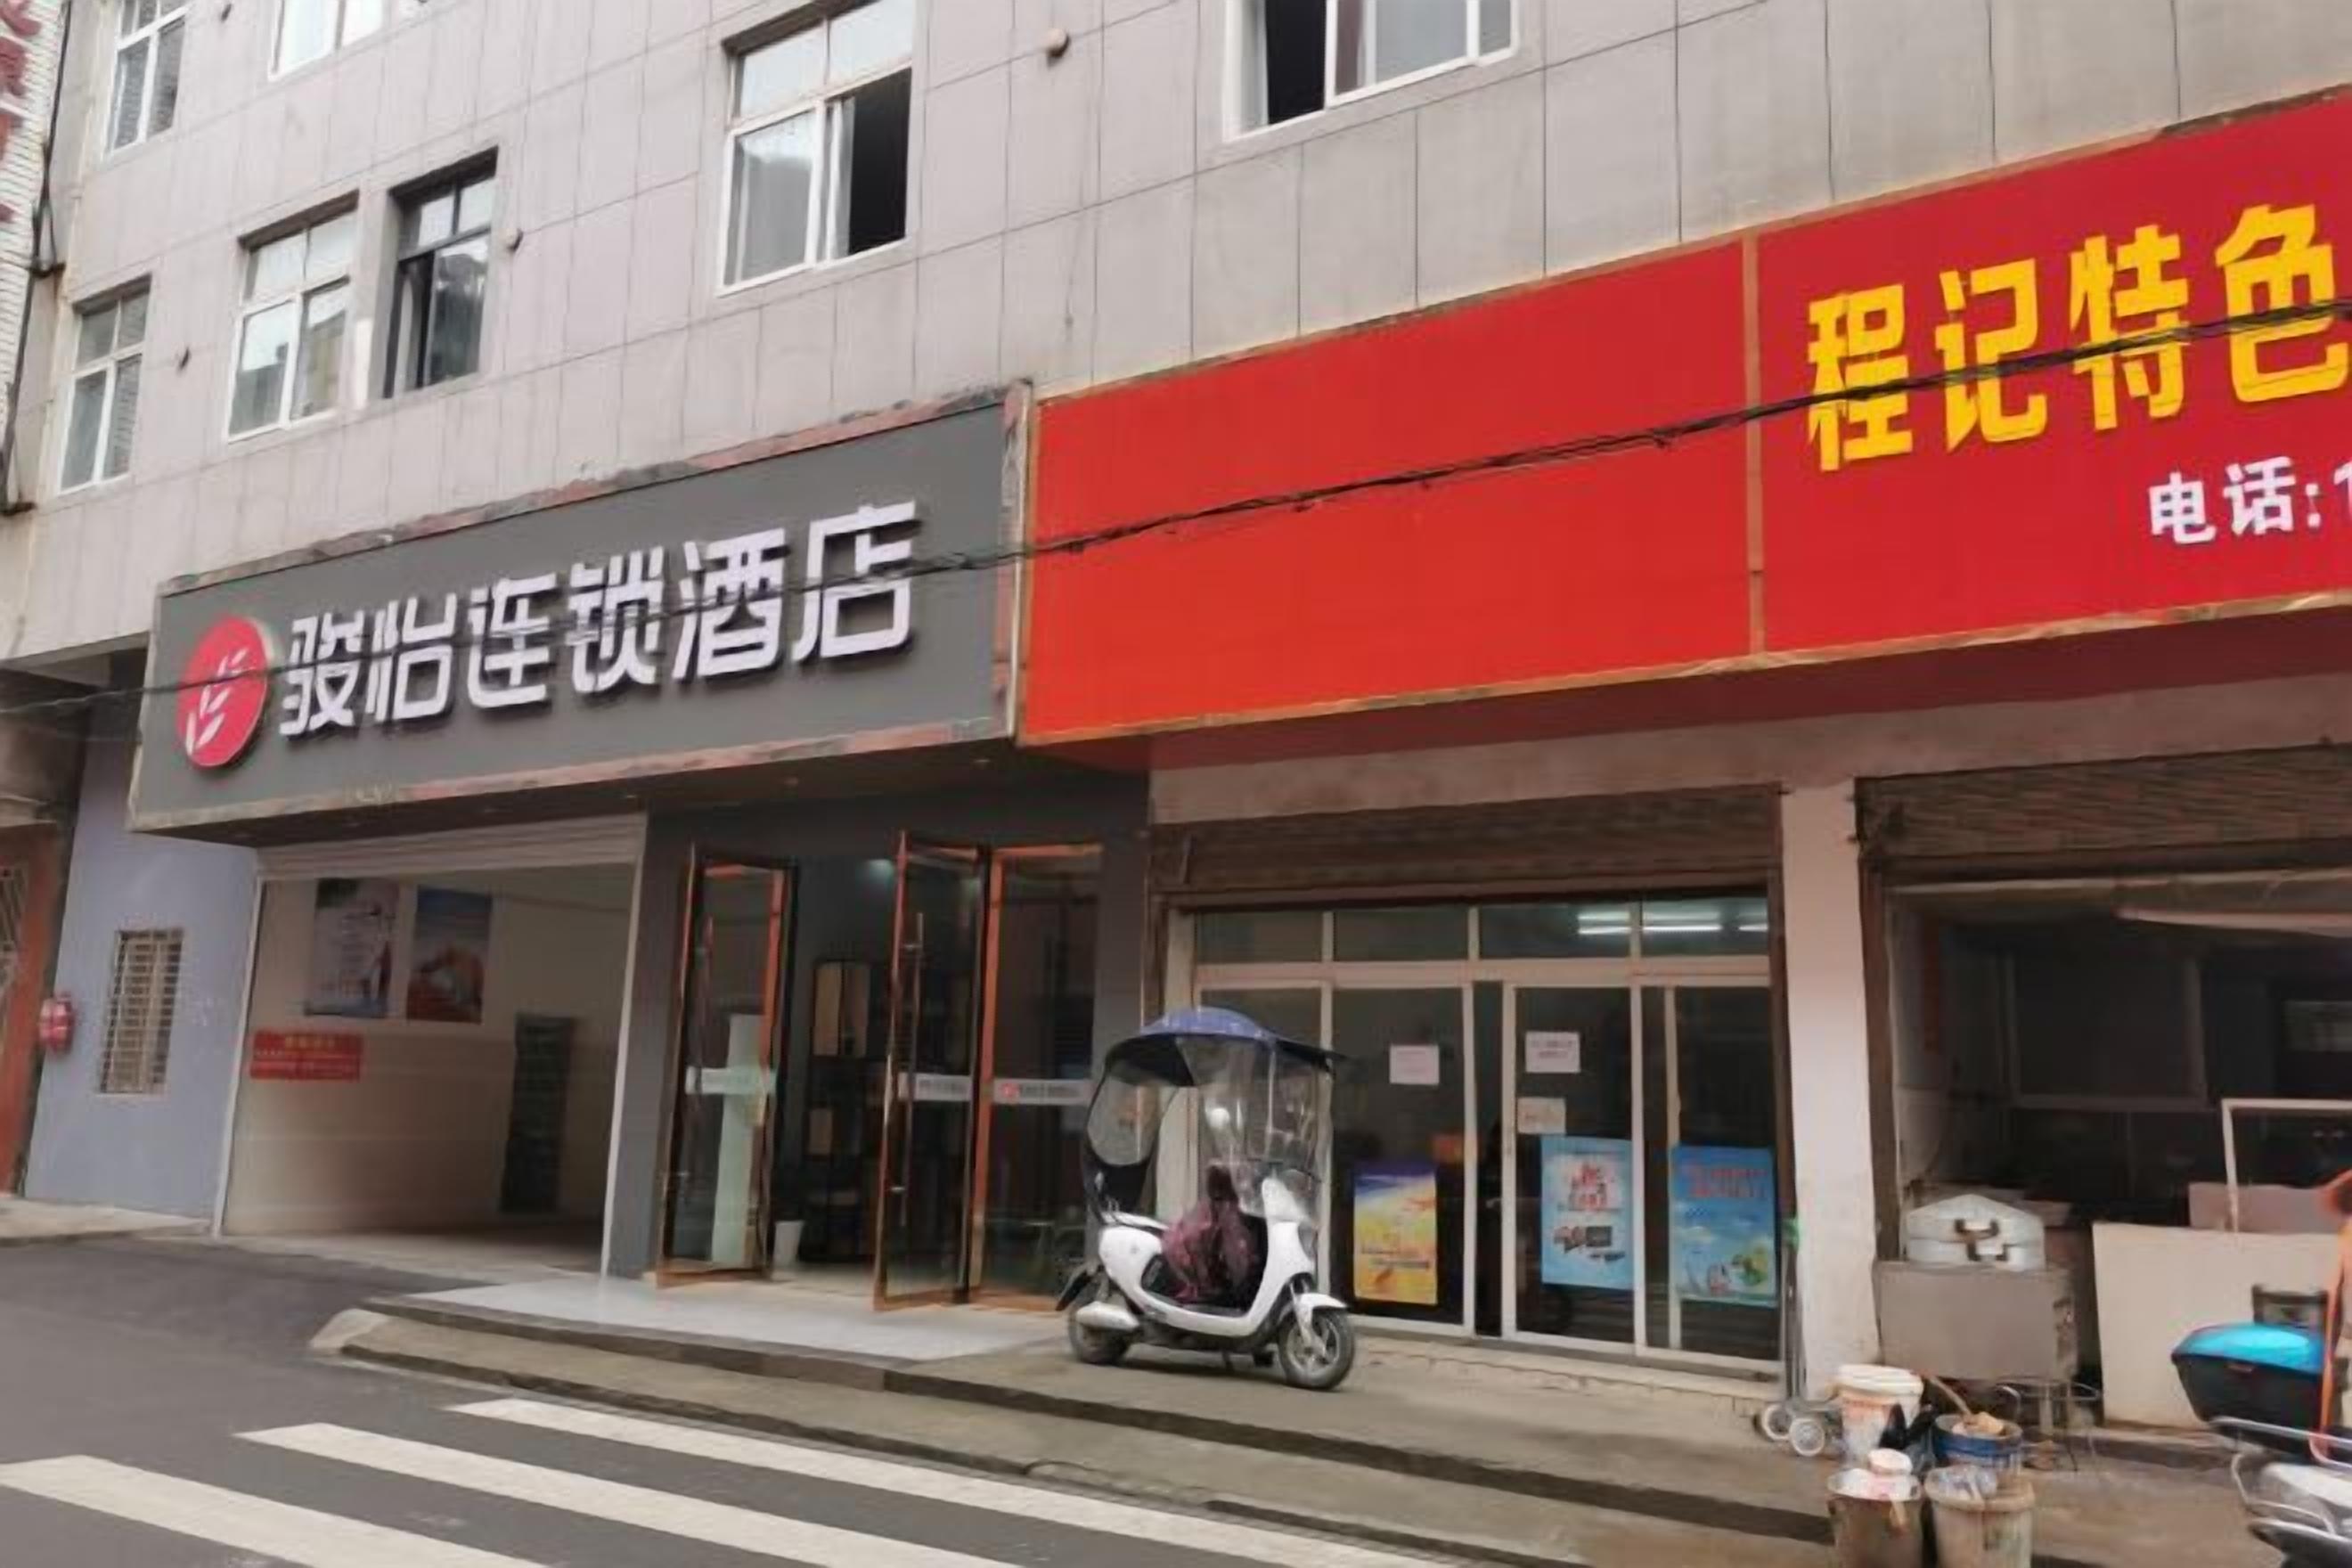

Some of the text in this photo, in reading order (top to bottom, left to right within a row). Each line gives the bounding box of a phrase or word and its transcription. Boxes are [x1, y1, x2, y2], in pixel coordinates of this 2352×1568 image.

[1809, 204, 2349, 470] 程记特色
[279, 502, 917, 736] 骏怡连锁酒店
